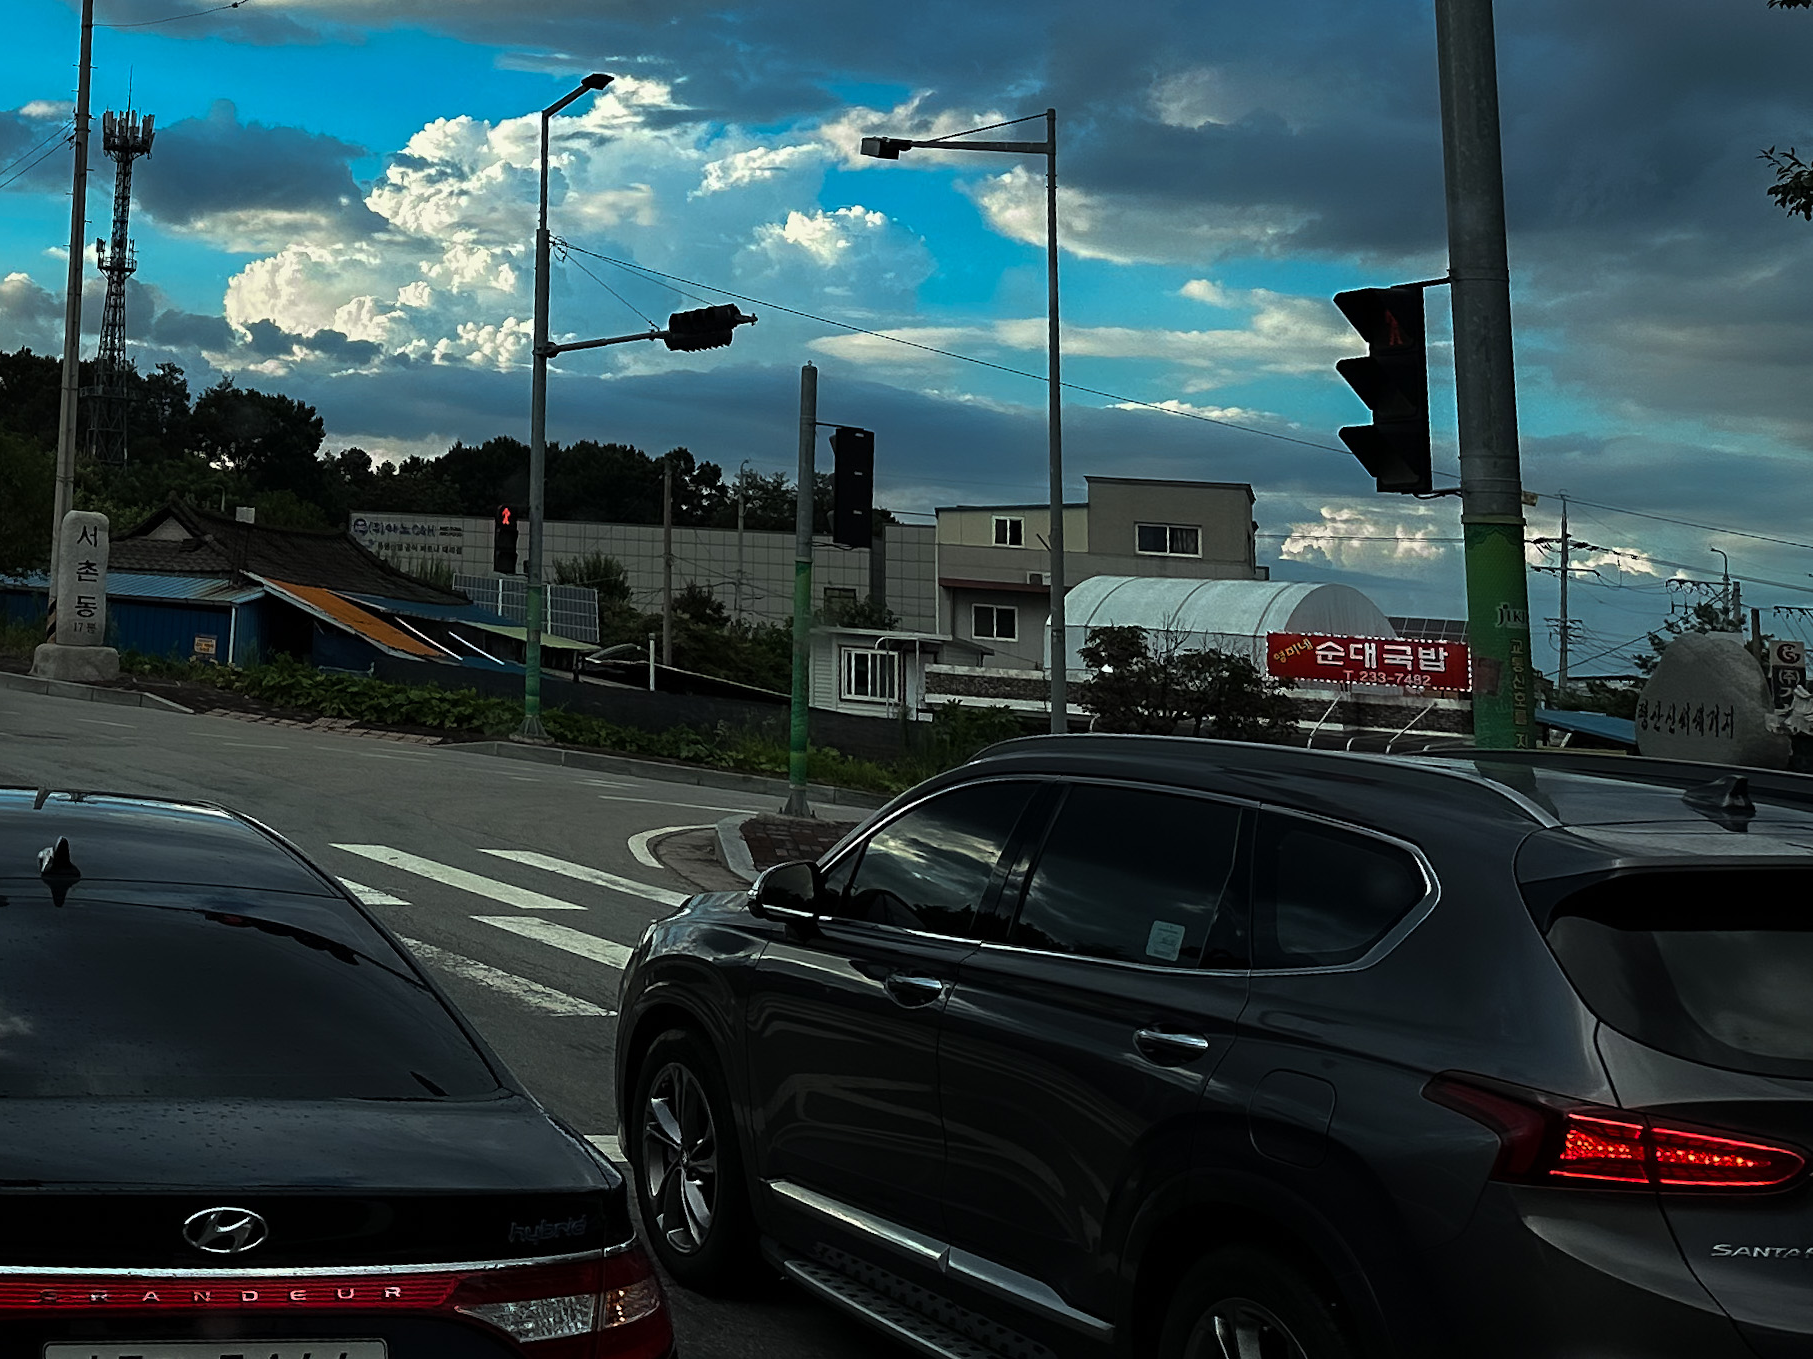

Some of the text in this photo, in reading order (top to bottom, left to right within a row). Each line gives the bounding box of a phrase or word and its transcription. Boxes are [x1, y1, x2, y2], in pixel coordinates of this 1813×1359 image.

[75, 525, 99, 618] 서촌동
[1314, 641, 1449, 672] 순대국밥
[507, 1214, 587, 1245] hybrid
[1710, 1243, 1801, 1259] SANTA
[39, 1284, 404, 1303] GRANDEUR
